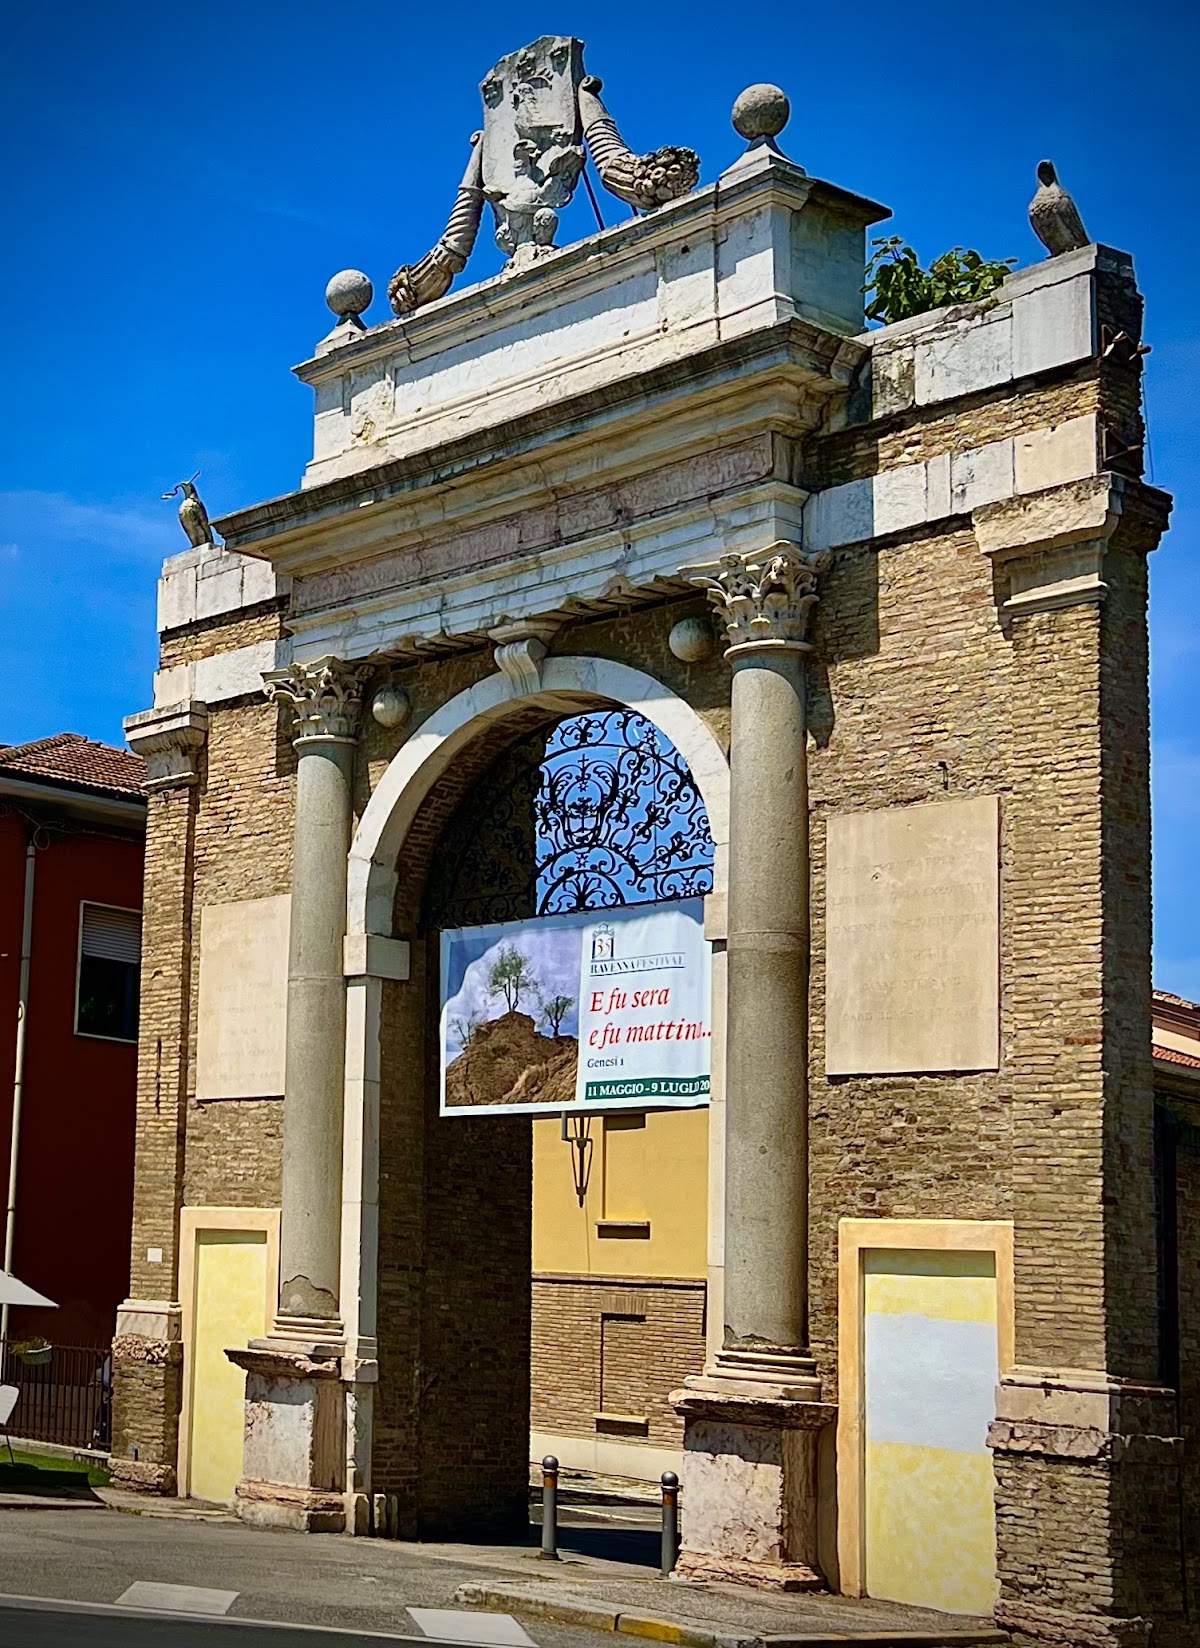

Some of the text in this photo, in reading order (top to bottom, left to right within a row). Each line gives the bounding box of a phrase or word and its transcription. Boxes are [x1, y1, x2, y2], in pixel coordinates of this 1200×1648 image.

[590, 987, 670, 1015] E fu sera
[589, 1028, 599, 1047] e
[597, 1022, 621, 1049] fu
[587, 1056, 618, 1068] Genesi
[587, 1086, 597, 1096] 11
[599, 1083, 644, 1096] MAGGIO
[651, 1082, 658, 1092] 9
[700, 1079, 711, 1091] 20
